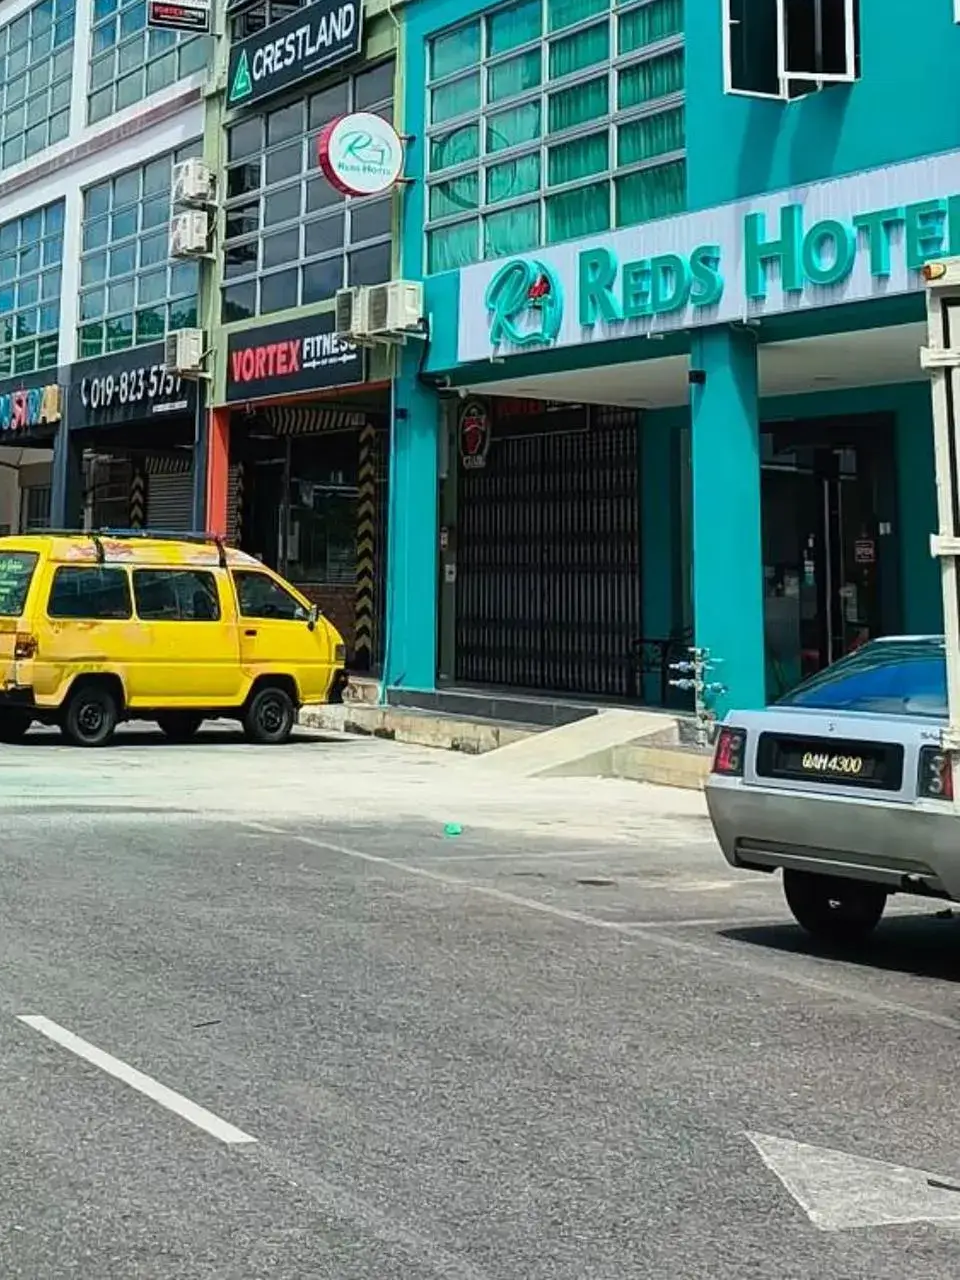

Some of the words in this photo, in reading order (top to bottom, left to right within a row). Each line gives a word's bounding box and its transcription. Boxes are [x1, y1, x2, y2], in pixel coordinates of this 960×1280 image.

[252, 2, 355, 81] CRESTLAND
[577, 242, 725, 327] REDS
[743, 194, 960, 299] HOTE
[231, 338, 302, 383] VORTEX
